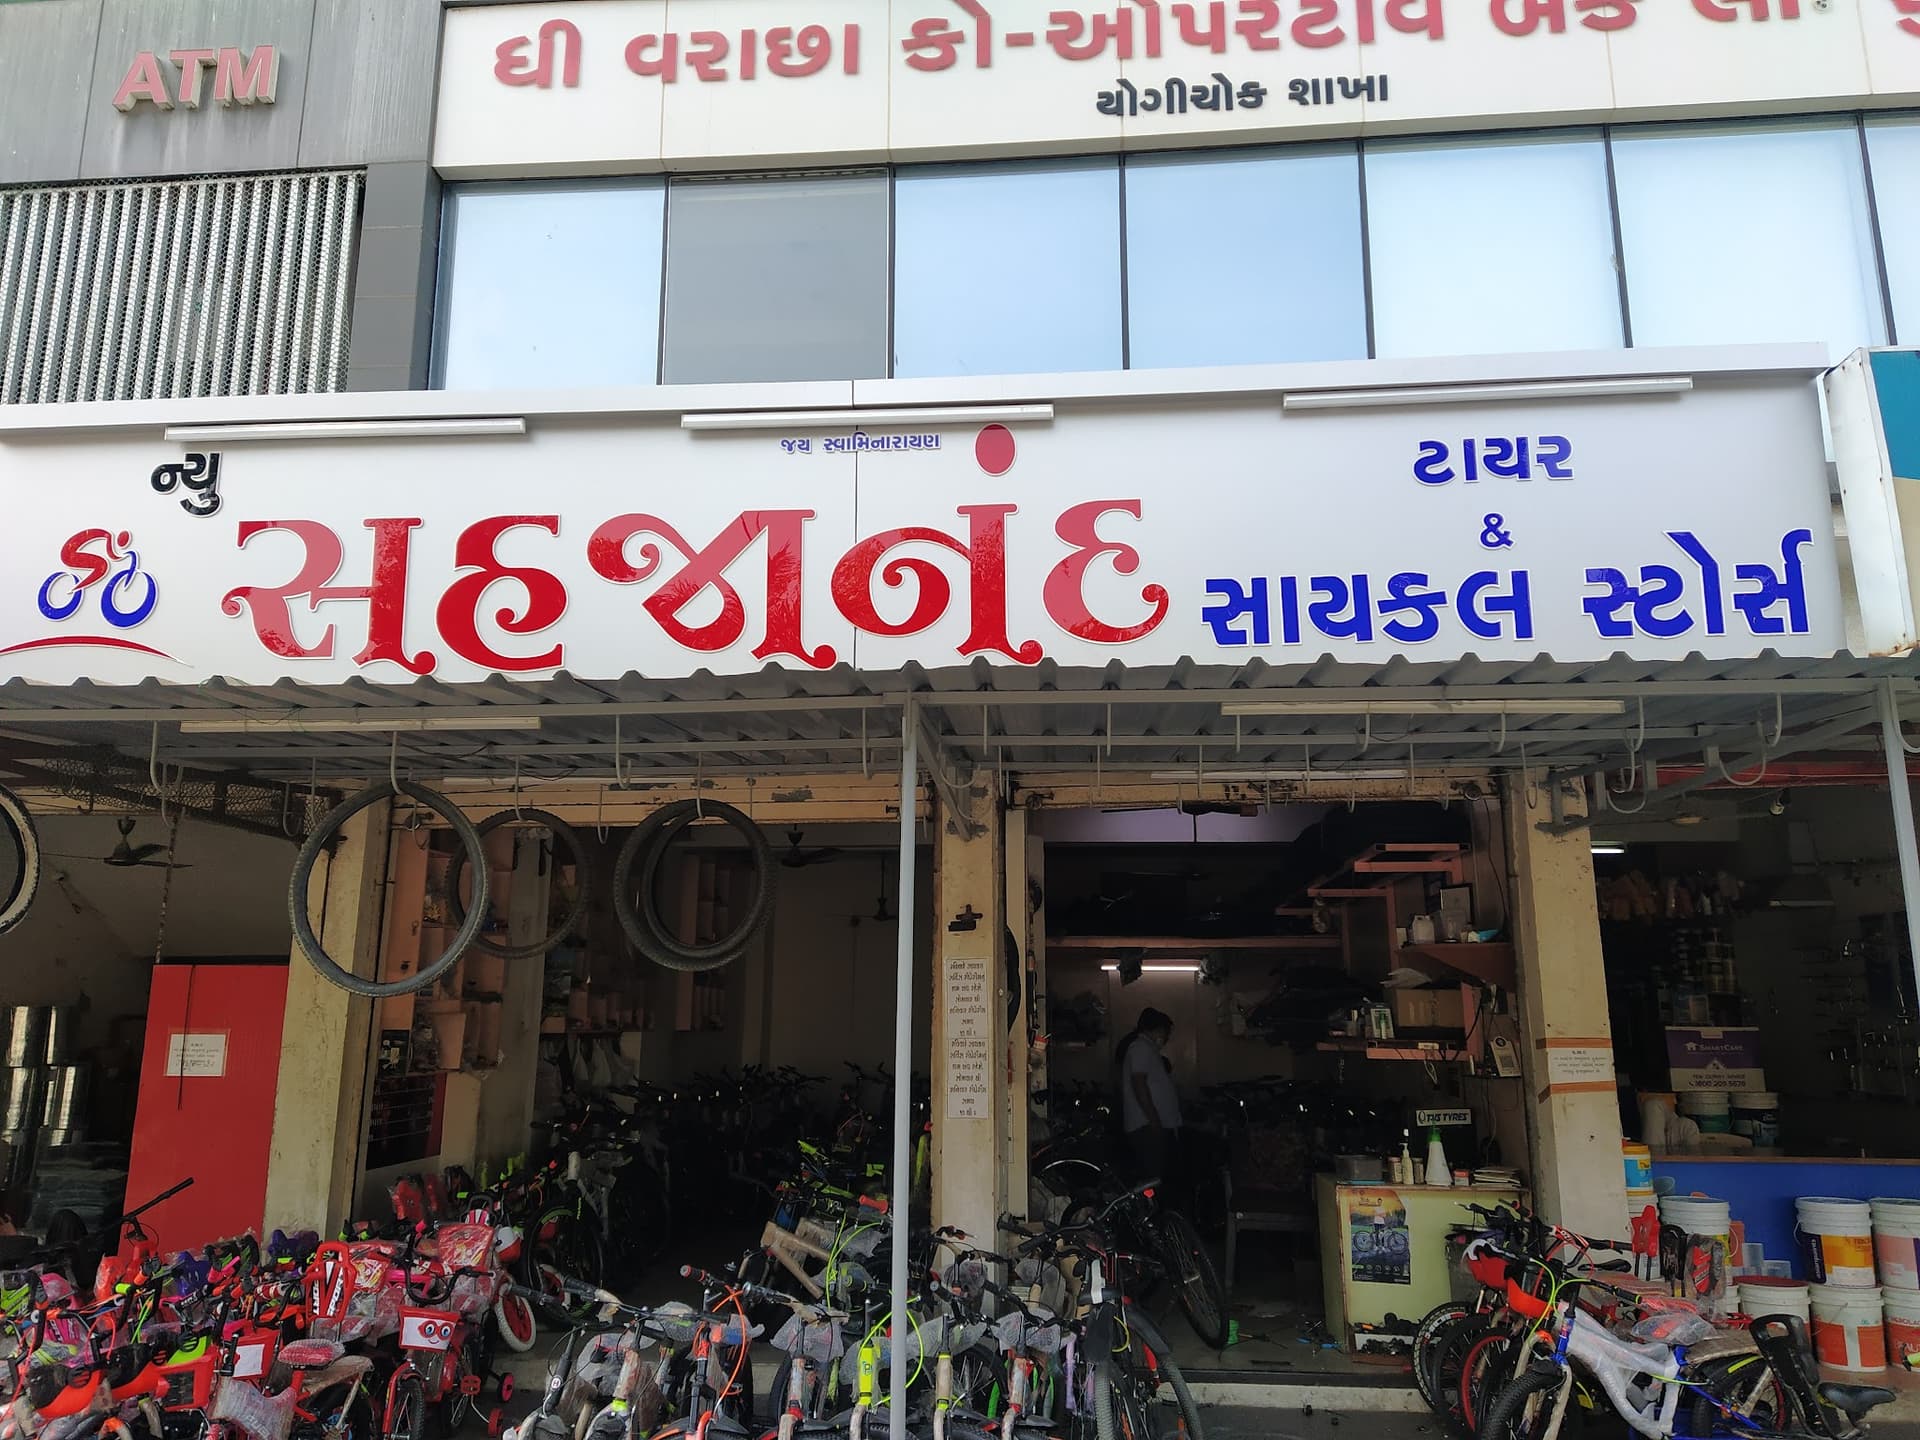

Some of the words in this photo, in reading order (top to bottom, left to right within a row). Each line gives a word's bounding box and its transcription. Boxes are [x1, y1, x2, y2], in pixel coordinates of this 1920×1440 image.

[113, 45, 280, 111] ATM
[625, 24, 860, 84] વરાછા
[1096, 73, 1266, 116] યોગીચોક
[1289, 75, 1388, 105] શાખા
[780, 438, 811, 454] જય
[823, 431, 941, 453] સ્વામિનારાયણ
[1413, 435, 1574, 484] ટાયર
[151, 449, 223, 516] ન્યુ
[221, 422, 1170, 676] સહજાનંદ
[1480, 512, 1514, 549] &
[1201, 570, 1533, 646] સાયકલ
[1582, 528, 1813, 638] સ્ટોર્સ
[1442, 1111, 1470, 1122] TYRES
